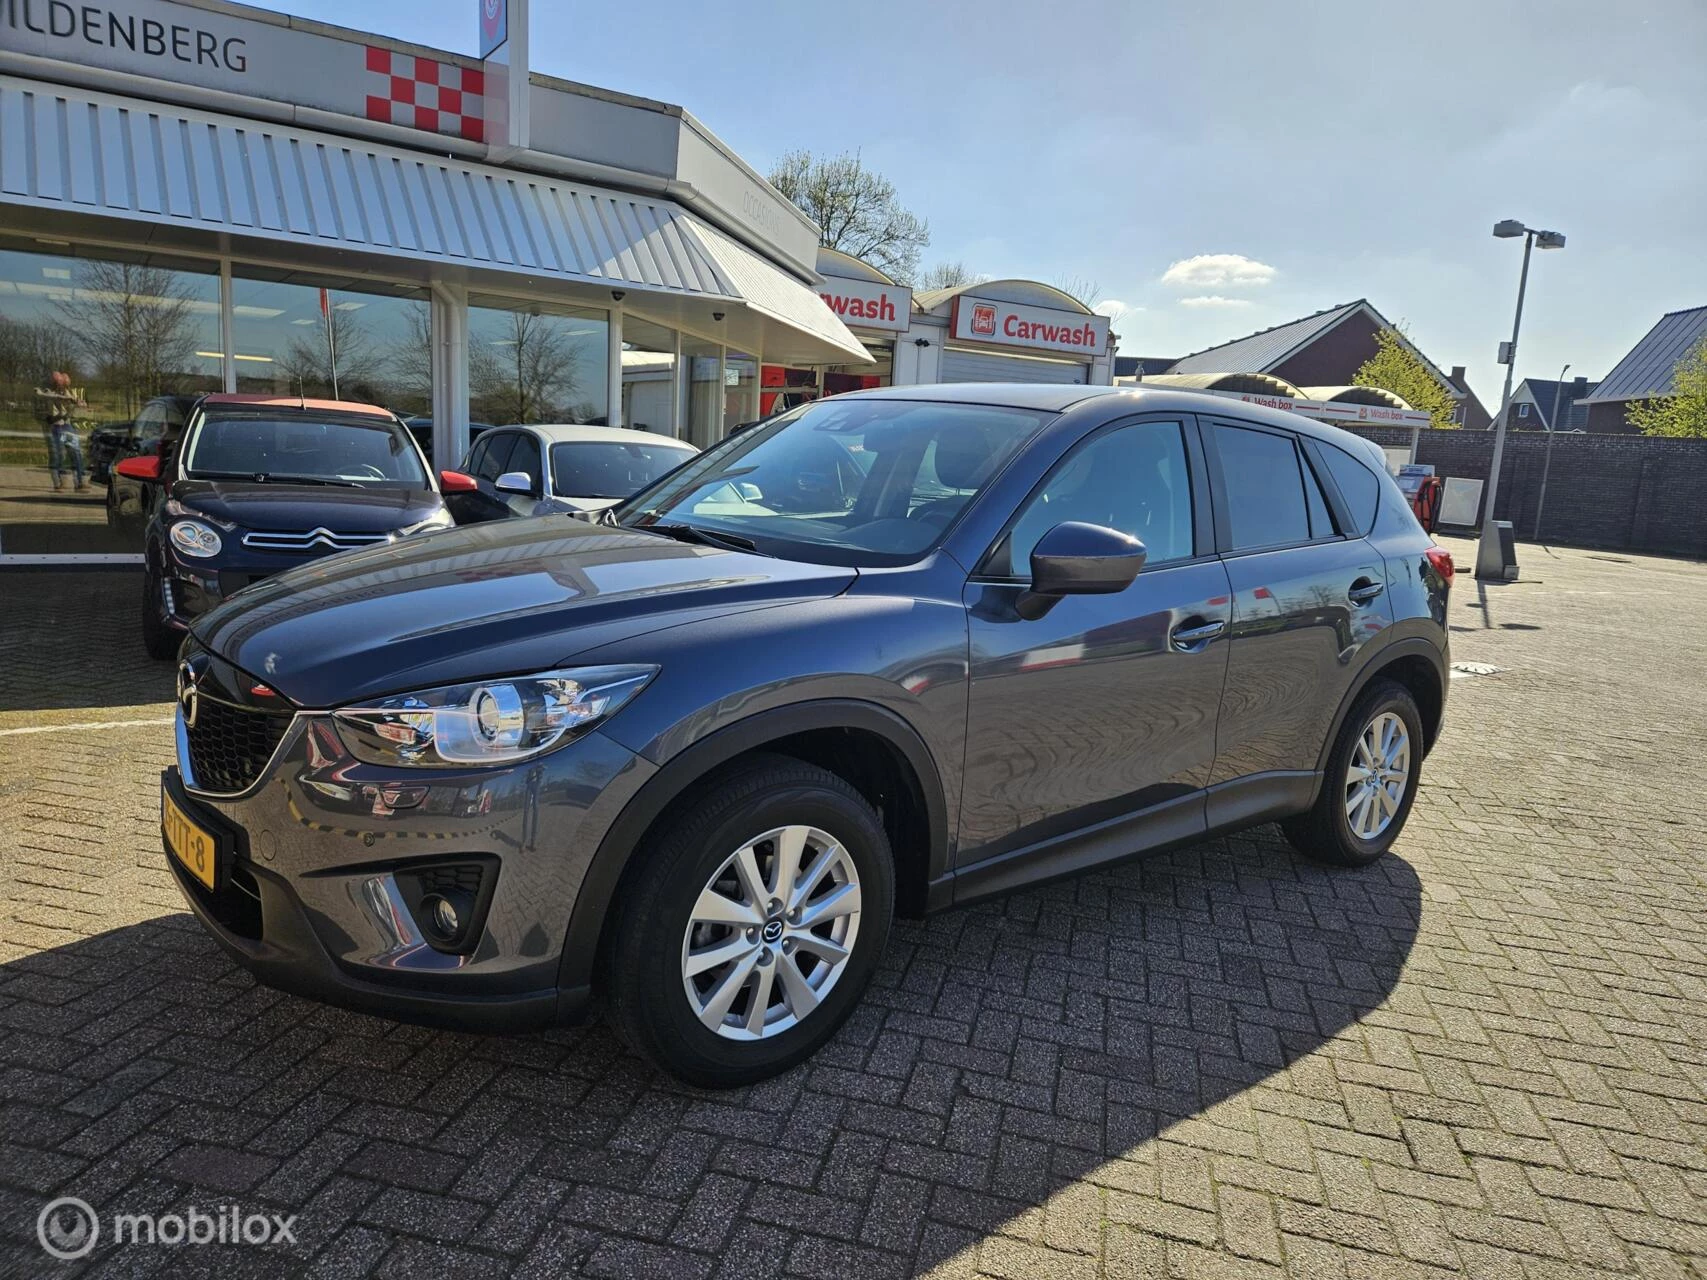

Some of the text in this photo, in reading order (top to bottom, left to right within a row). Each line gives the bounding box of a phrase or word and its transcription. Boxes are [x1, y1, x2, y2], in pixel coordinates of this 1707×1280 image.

[0, 0, 247, 73] ILDENBERG
[1003, 314, 1097, 348] Carwash
[1254, 396, 1293, 410] Wash box
[1370, 408, 1404, 420] Wash box
